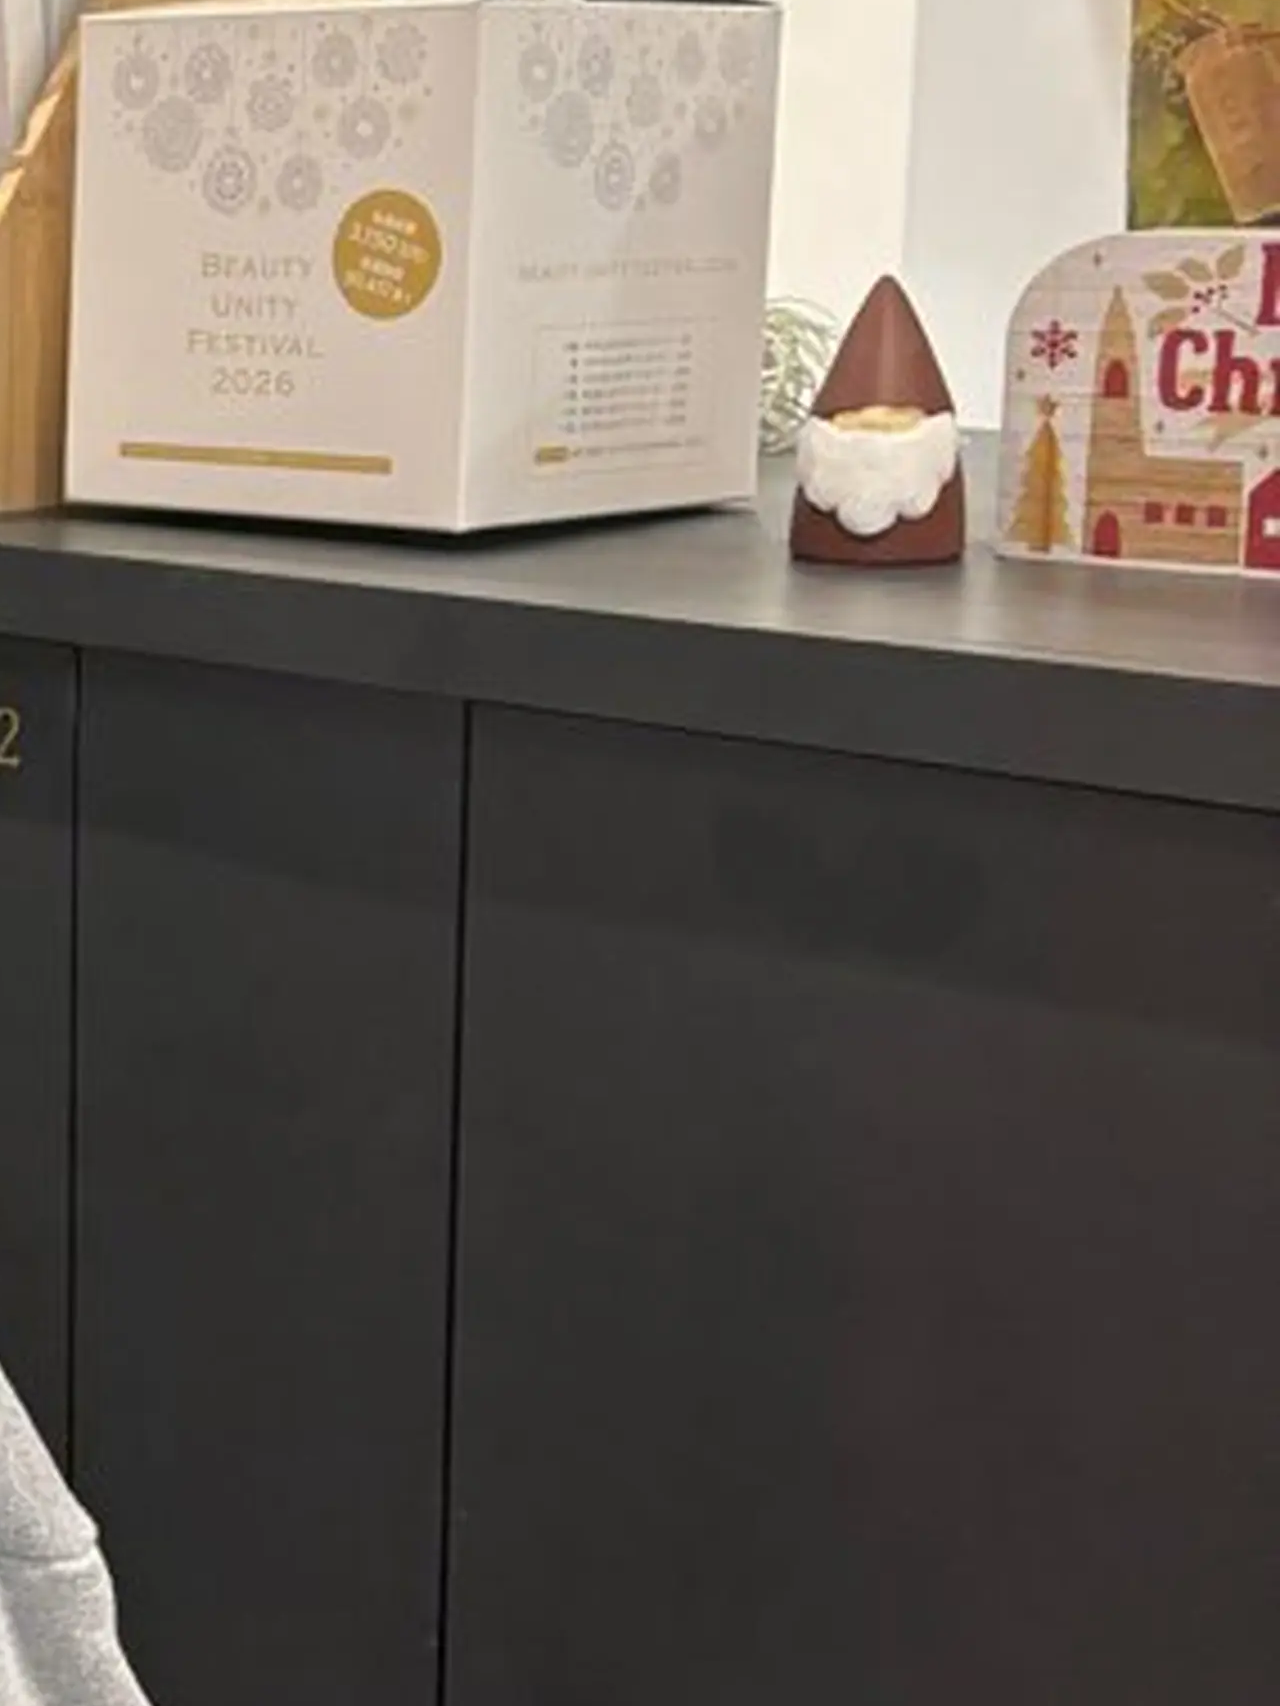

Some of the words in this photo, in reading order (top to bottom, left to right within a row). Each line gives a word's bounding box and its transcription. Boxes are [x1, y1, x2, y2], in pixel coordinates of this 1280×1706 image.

[200, 251, 316, 280] BEAUTY
[210, 291, 300, 318] UNITY
[186, 328, 325, 359] FESTIVAL
[210, 366, 296, 397] 2026
